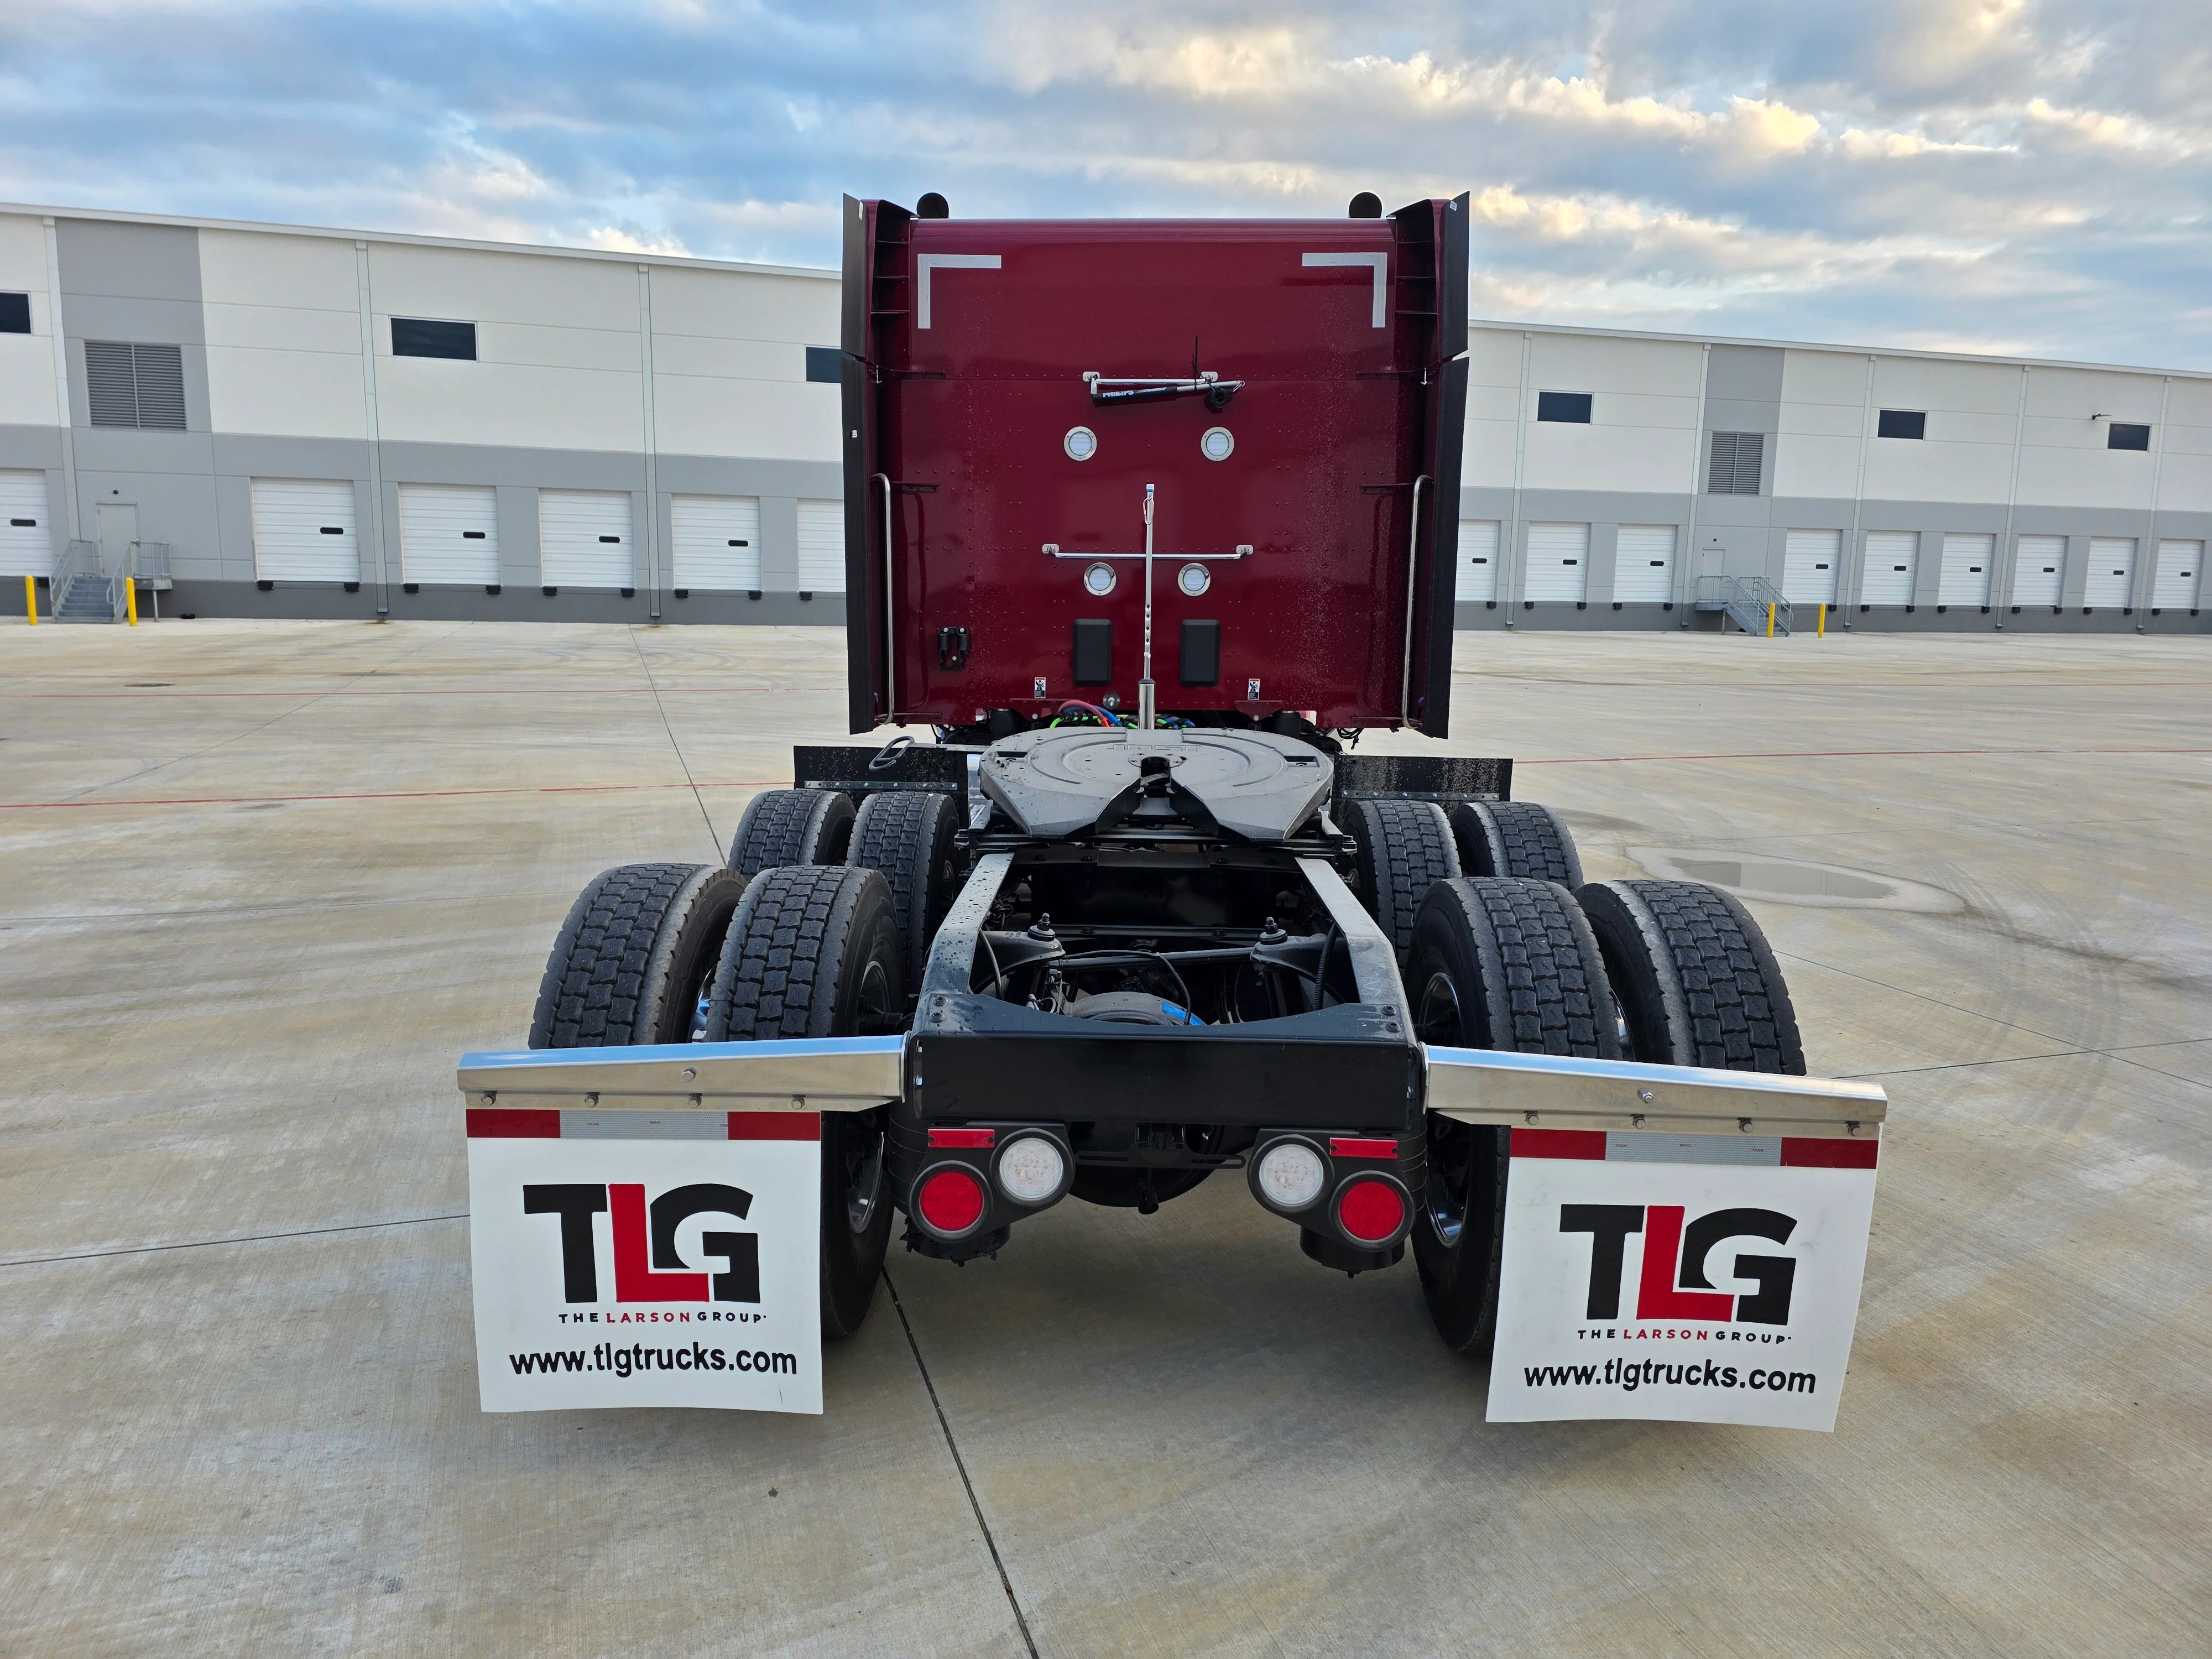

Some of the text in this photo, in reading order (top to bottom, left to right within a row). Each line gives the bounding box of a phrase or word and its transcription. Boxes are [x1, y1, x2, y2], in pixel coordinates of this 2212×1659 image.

[523, 1183, 760, 1303] TLG
[1559, 1204, 1797, 1326] TLG
[559, 1311, 761, 1324] THE LARSON GROUP
[1578, 1329, 1785, 1344] THE LARSON GROUP
[509, 1342, 797, 1378] www.tlgtrucks.com
[1524, 1358, 1816, 1394] www.tlgtrucks.com
